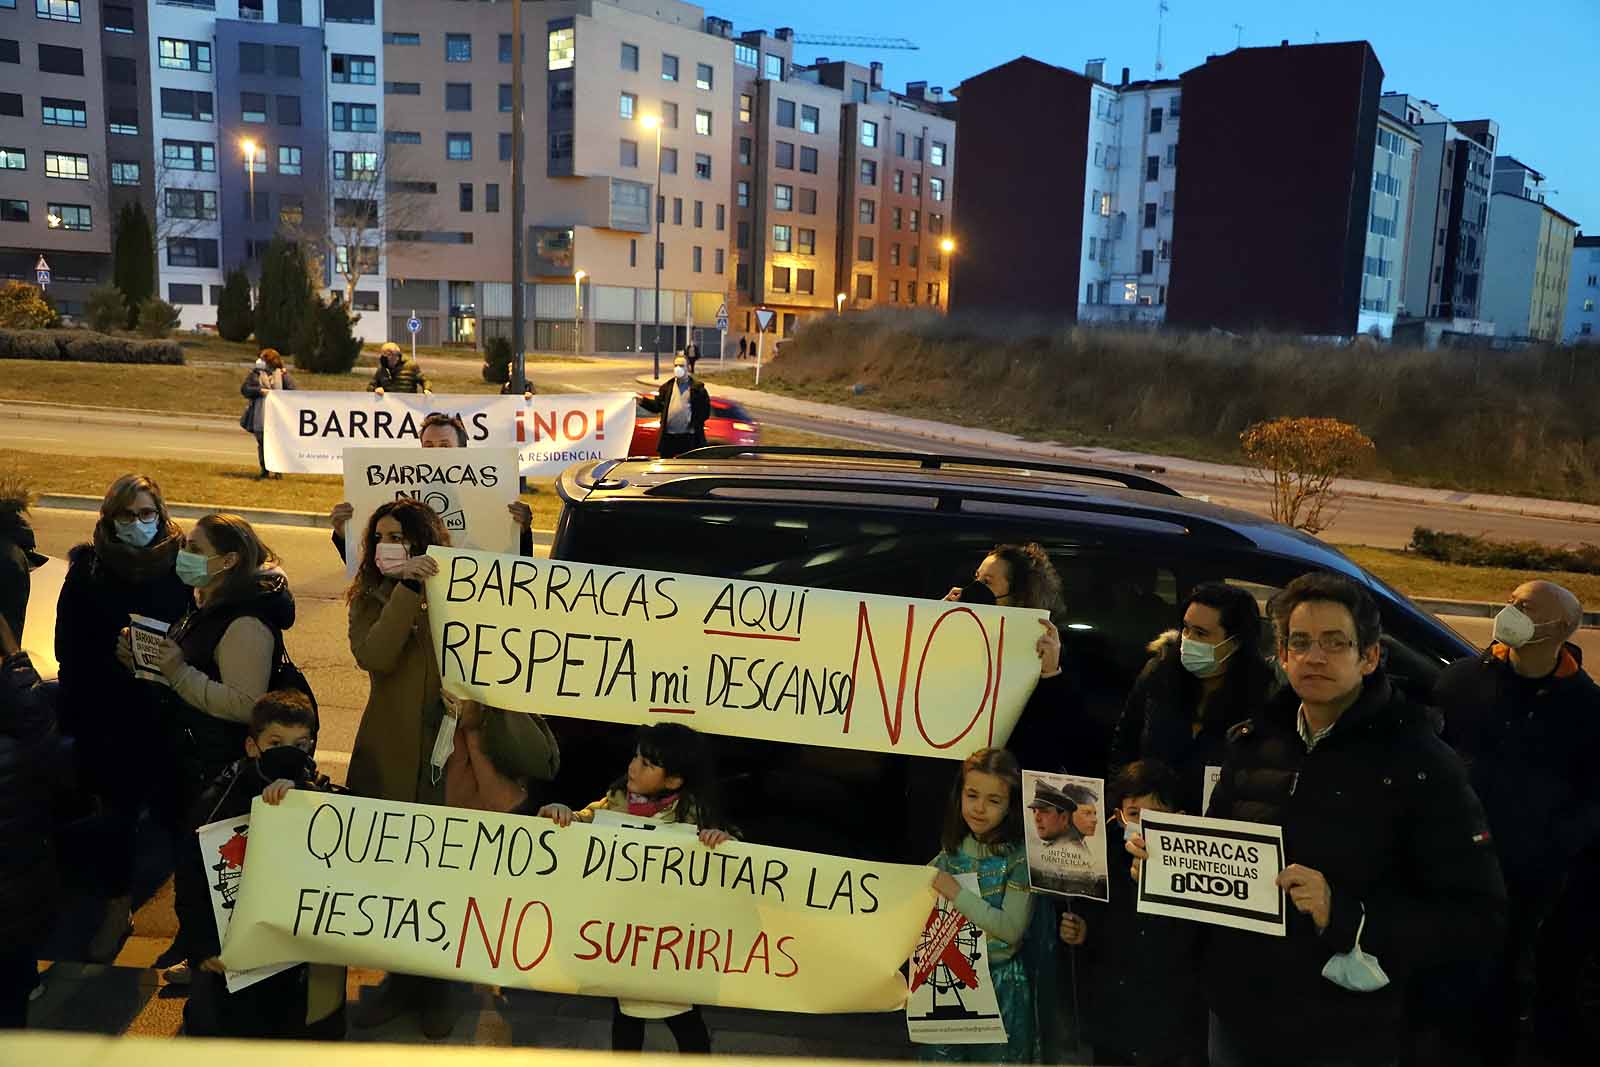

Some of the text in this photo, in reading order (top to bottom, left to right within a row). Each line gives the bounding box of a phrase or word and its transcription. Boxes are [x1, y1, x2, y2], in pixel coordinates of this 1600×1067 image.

[516, 409, 604, 442] ¡NO!
[366, 464, 498, 487] BARRACAS
[446, 517, 463, 528] NO
[446, 556, 678, 621] BARRACAS
[441, 621, 852, 716] RESPETA mi DESCANSO
[307, 803, 880, 914] QUEREMOS DISFRUTAR LAS
[1160, 835, 1259, 864] BARRACAS
[1162, 855, 1258, 880] EN FUENTECILLAS
[1171, 872, 1249, 900] ¡NO!
[293, 886, 800, 978] FIESTAS, NO SUFRIRLAS
